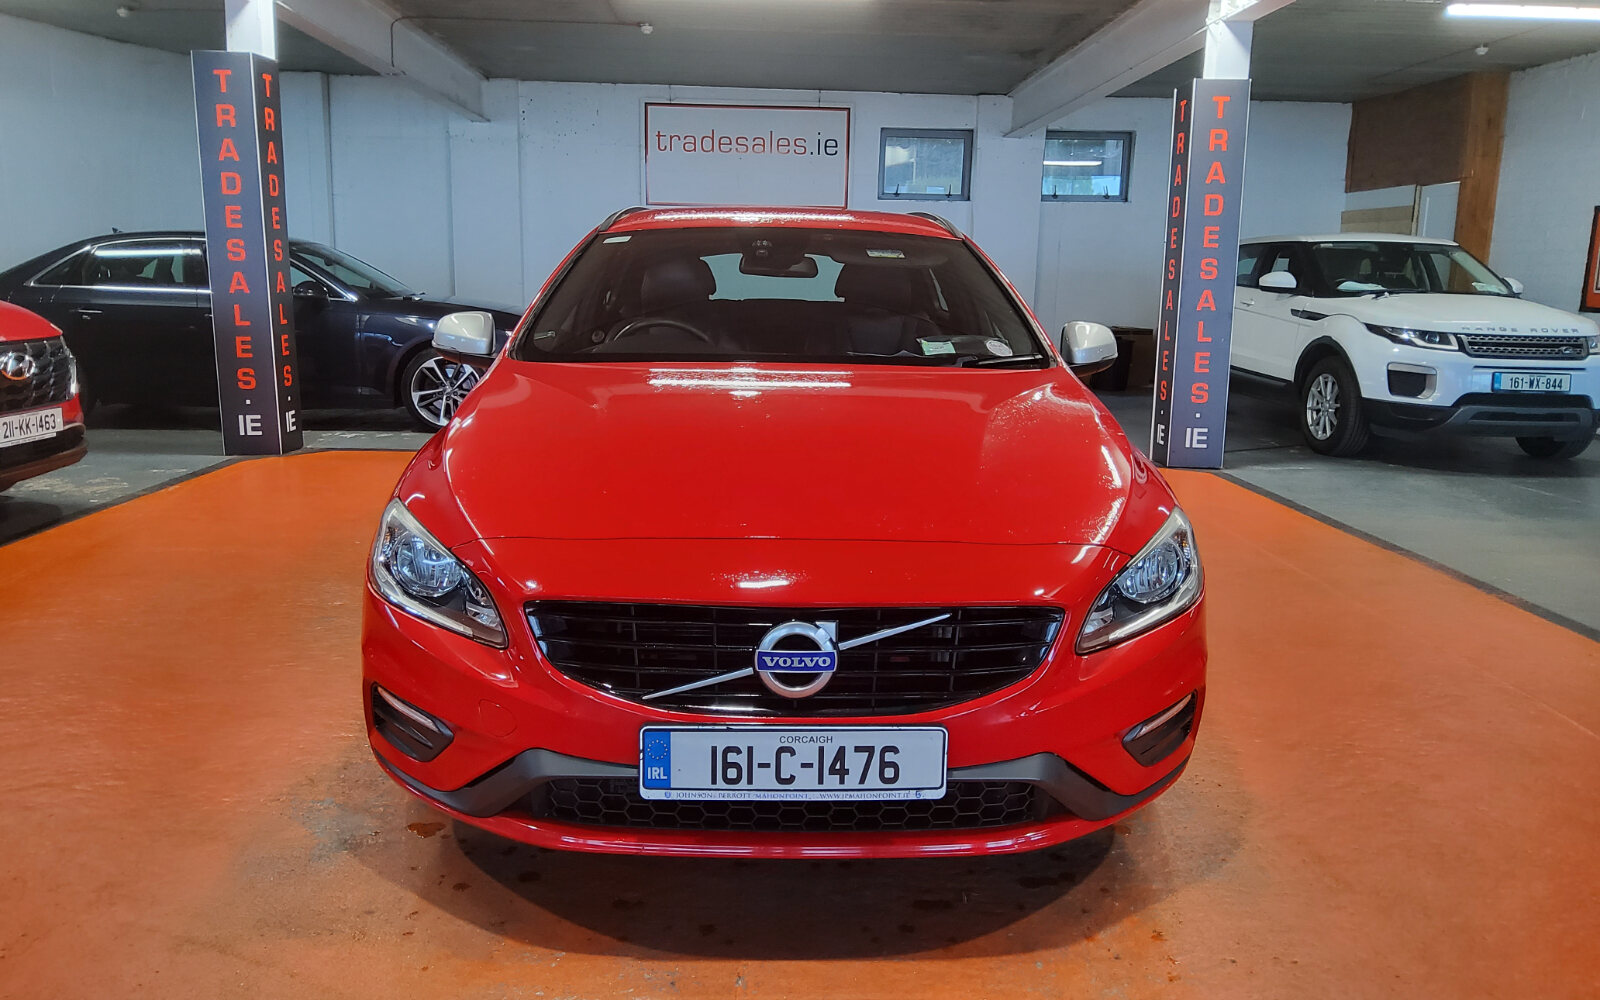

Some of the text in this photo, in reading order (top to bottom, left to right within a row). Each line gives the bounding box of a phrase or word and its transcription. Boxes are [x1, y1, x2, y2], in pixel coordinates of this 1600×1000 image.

[655, 129, 839, 156] tradesales.ie
[1509, 377, 1563, 390] 161-WX-844
[2, 413, 57, 439] 211-KK-1463
[762, 656, 831, 668] VOLVO
[779, 735, 834, 744] CORCAIGH
[710, 745, 901, 786] 161-C-1476
[647, 767, 668, 780] IRL
